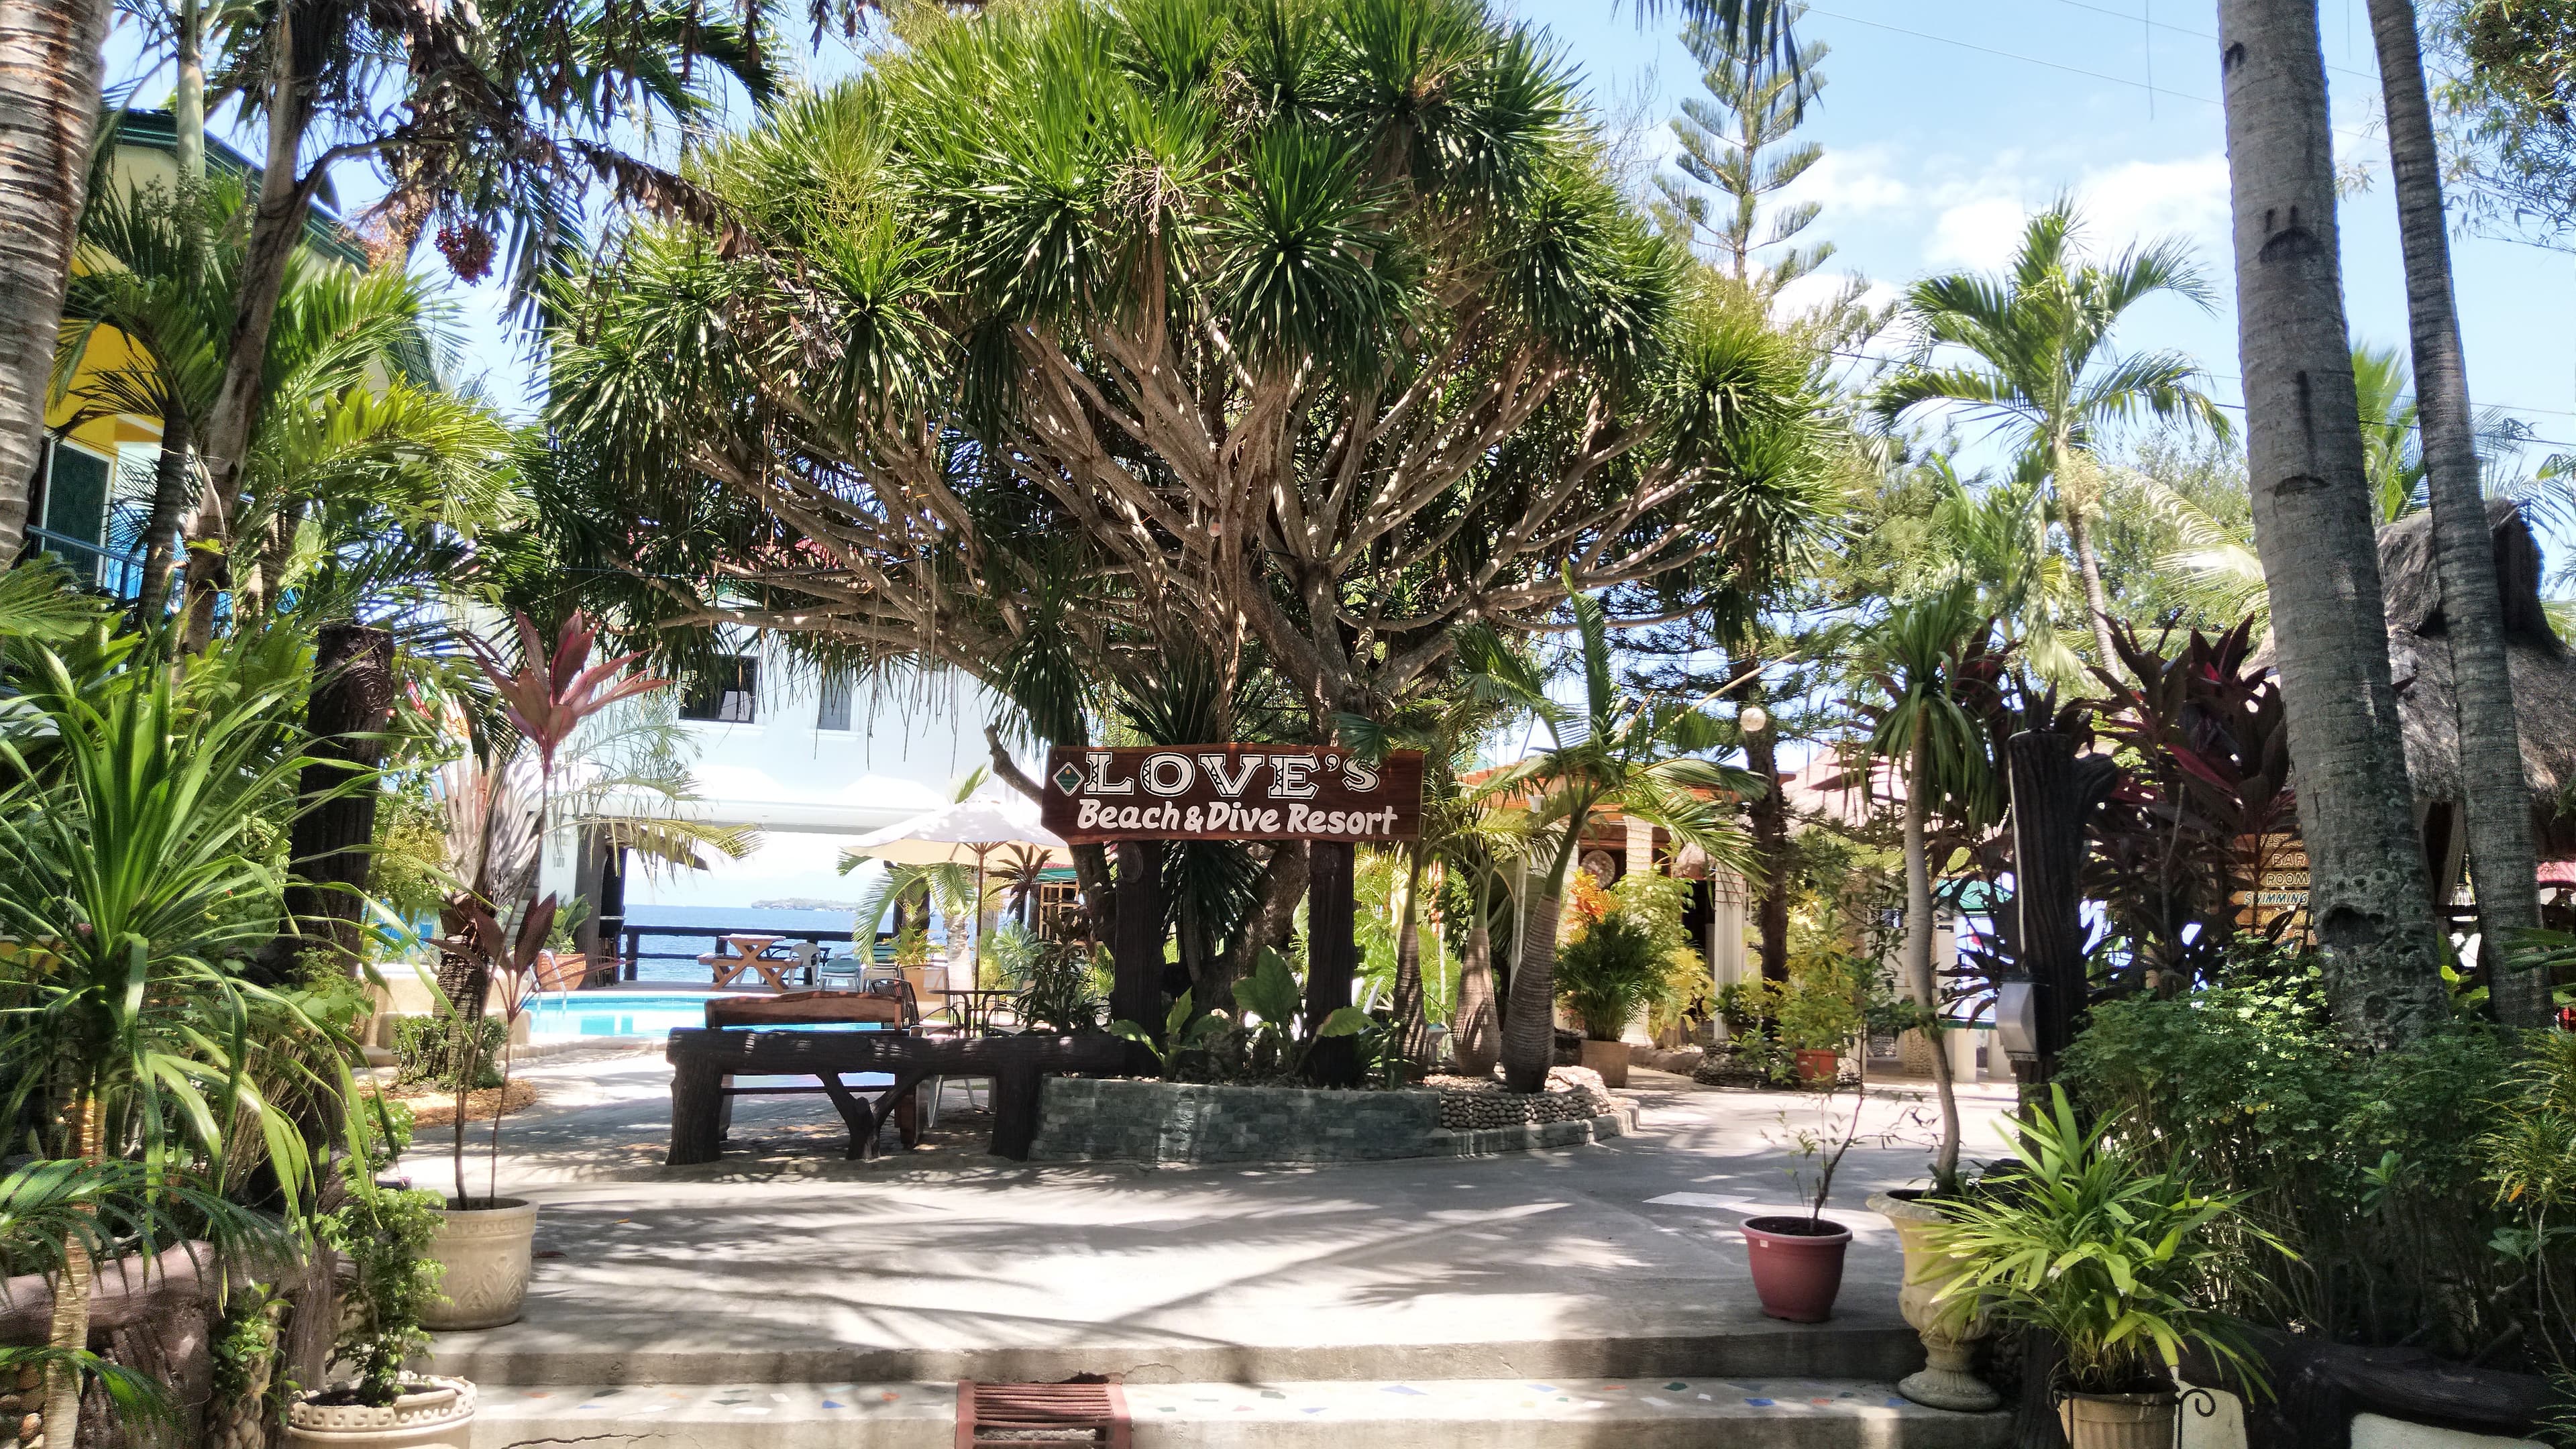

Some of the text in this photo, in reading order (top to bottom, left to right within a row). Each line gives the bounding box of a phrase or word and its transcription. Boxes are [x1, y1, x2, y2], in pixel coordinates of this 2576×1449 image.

[1084, 751, 1381, 800] LOVE'S
[1077, 799, 1180, 829] Beach
[1206, 802, 1281, 833] Dive
[1287, 804, 1398, 835] Resort
[2272, 853, 2306, 866] BAR
[2266, 872, 2310, 885] ROOM
[2244, 891, 2308, 906] SWIMMING
